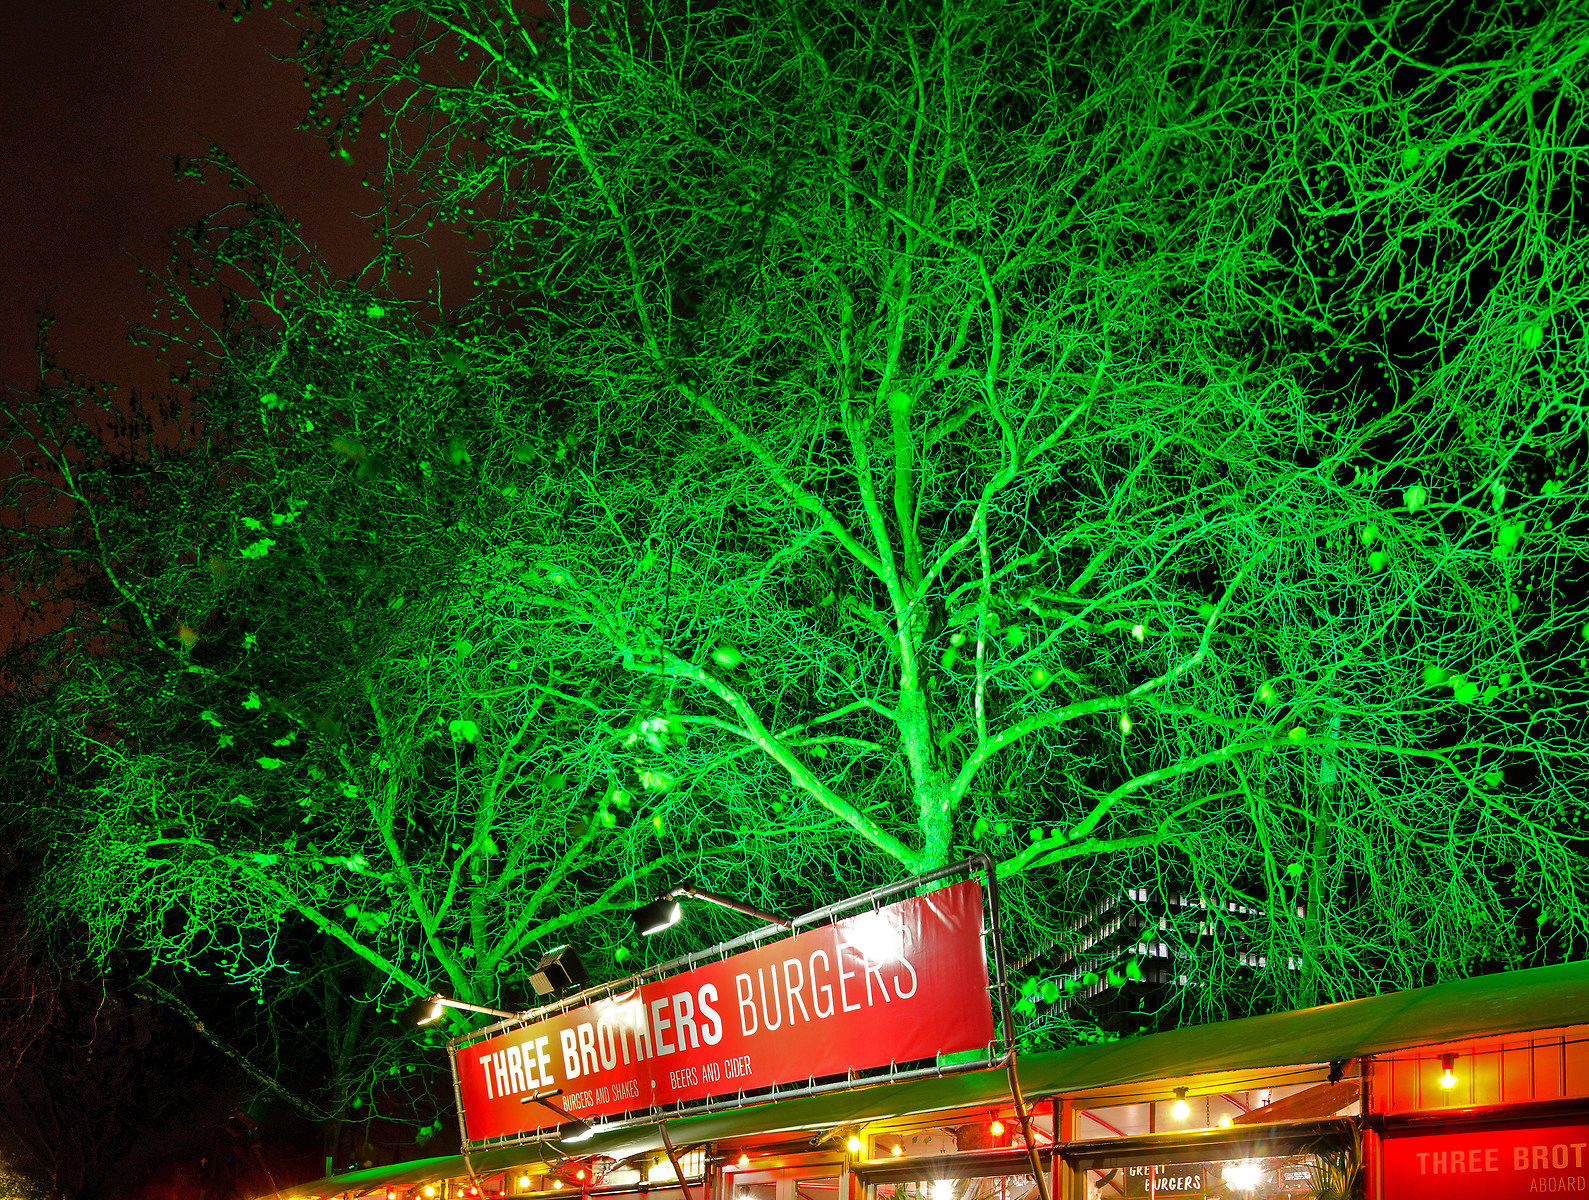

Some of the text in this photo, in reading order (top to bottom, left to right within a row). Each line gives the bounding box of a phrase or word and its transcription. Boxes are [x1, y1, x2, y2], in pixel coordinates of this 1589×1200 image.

[479, 925, 918, 1100] THREE BROTHERS BURGERS
[670, 1055, 753, 1090] BEERS AND CIDER
[562, 1079, 640, 1112] BURGERS AND SHAKES
[1416, 1143, 1587, 1175] THREE BROT
[1145, 1175, 1202, 1192] BURGERS
[1529, 1176, 1586, 1193] ABOARD
